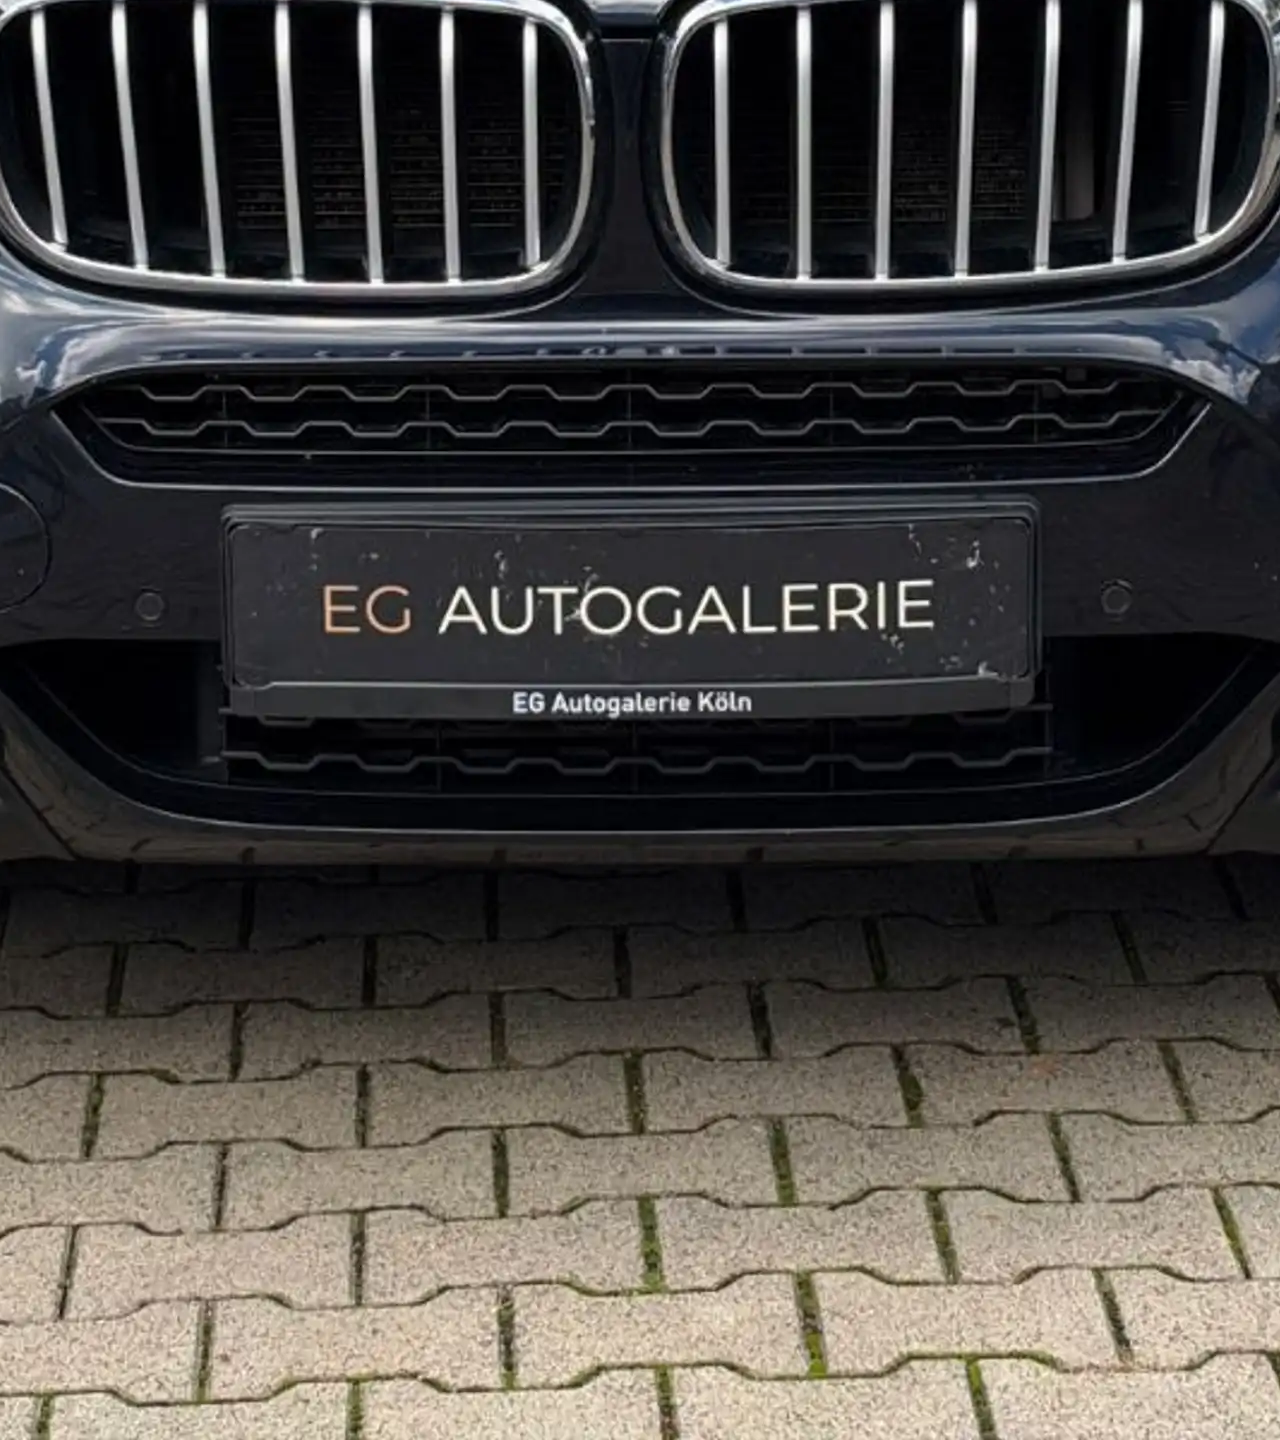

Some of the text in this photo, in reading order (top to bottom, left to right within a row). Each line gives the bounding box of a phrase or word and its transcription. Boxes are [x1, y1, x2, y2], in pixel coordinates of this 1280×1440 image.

[323, 580, 934, 636] EG AUTOGALERIE
[513, 690, 753, 719] EG Autogalerie Köln
